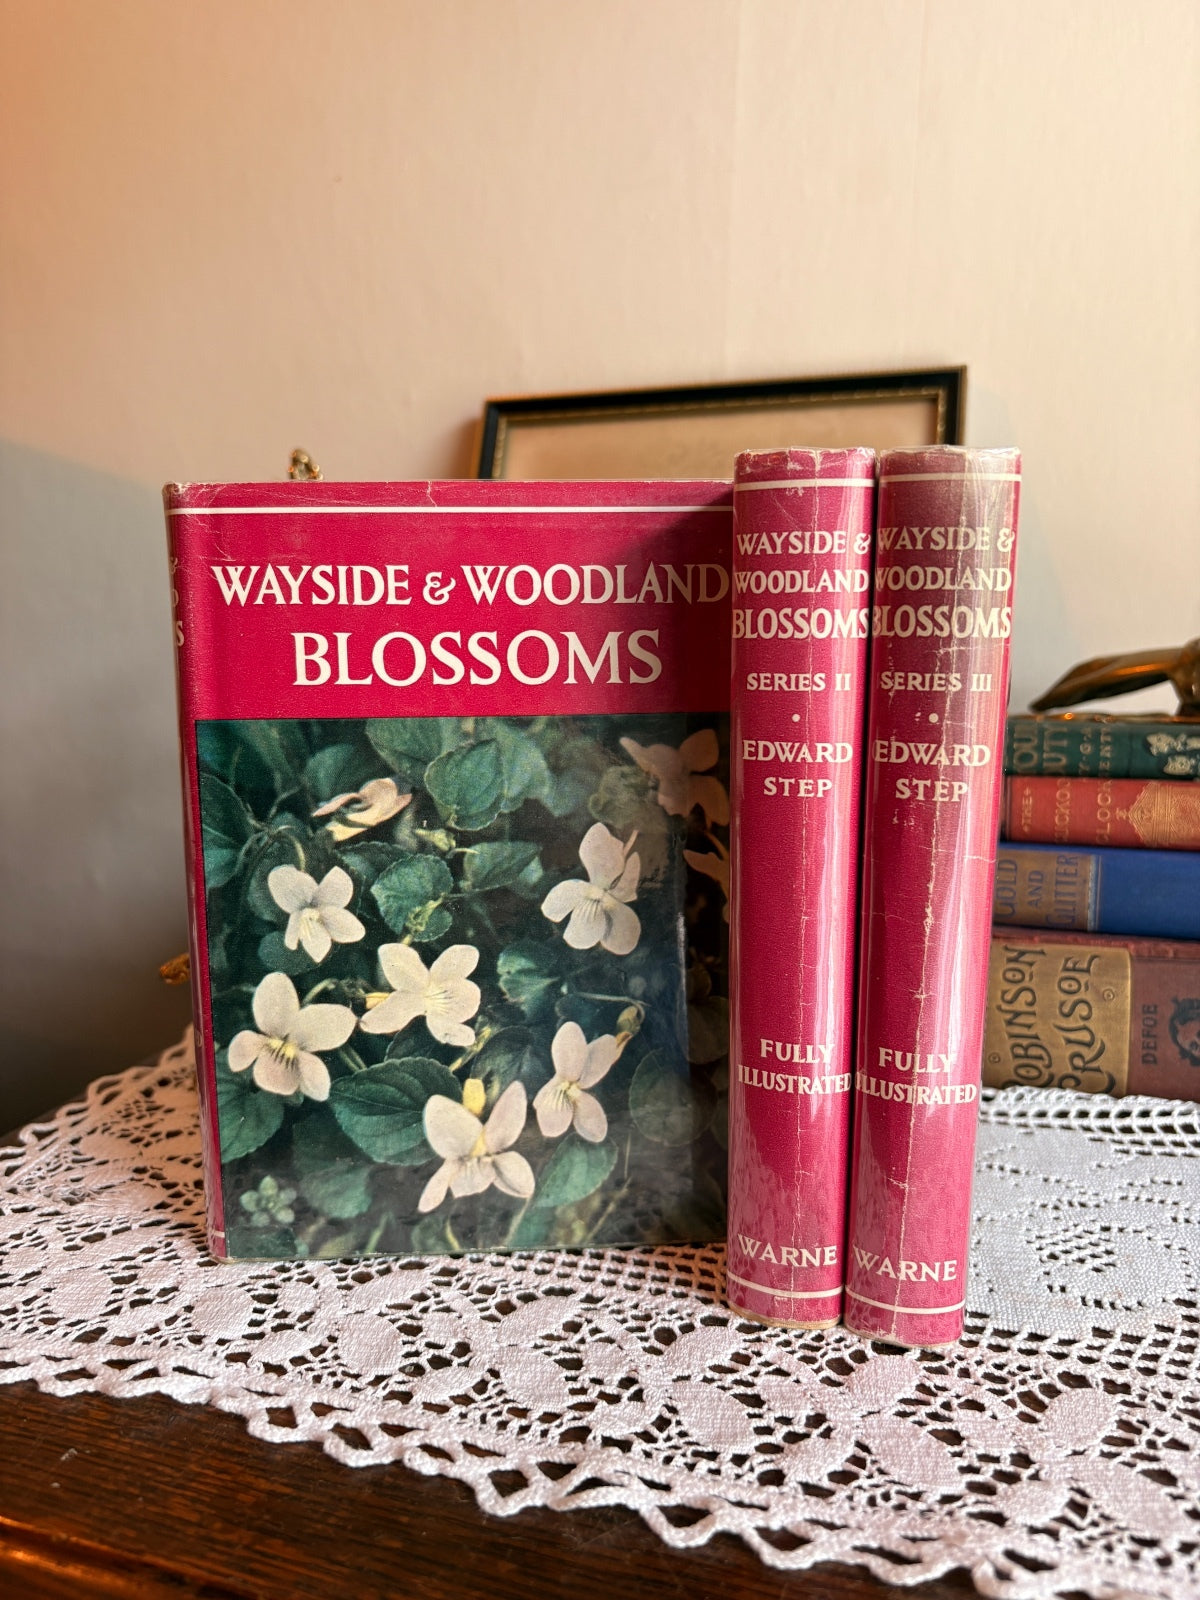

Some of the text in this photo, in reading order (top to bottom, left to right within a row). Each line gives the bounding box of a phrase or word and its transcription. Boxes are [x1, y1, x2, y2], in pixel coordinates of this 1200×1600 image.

[737, 531, 871, 555] WAYSIDE &
[877, 526, 1015, 554] WAYSIDE &
[211, 563, 412, 607] WAYSIDE
[423, 571, 456, 605] &
[460, 561, 730, 606] WOODLAND
[735, 570, 869, 594] WOODLAND
[875, 565, 1012, 592] WOODLAND
[732, 608, 869, 639] BLOSSOMS
[872, 604, 1012, 639] BLOSSOMS
[291, 629, 663, 686] BLOSSOMS
[746, 673, 851, 692] SERIES II
[880, 672, 992, 692] SERIES III
[742, 740, 853, 764] EDWARD
[874, 739, 991, 767] EDWARD
[763, 777, 832, 798] STEP
[895, 779, 969, 801] STEP
[1022, 796, 1032, 825] THE
[1027, 870, 1044, 908] AND
[1046, 854, 1079, 927] GLITTER
[1141, 1002, 1158, 1065] DEFOE
[760, 1038, 835, 1064] FULLY
[878, 1046, 957, 1073] FULLY
[738, 1064, 851, 1095] ILLUSTRATED
[857, 1071, 977, 1105] ILLUSTRATED
[737, 1233, 837, 1268] WARNE
[853, 1244, 957, 1282] WARNE
